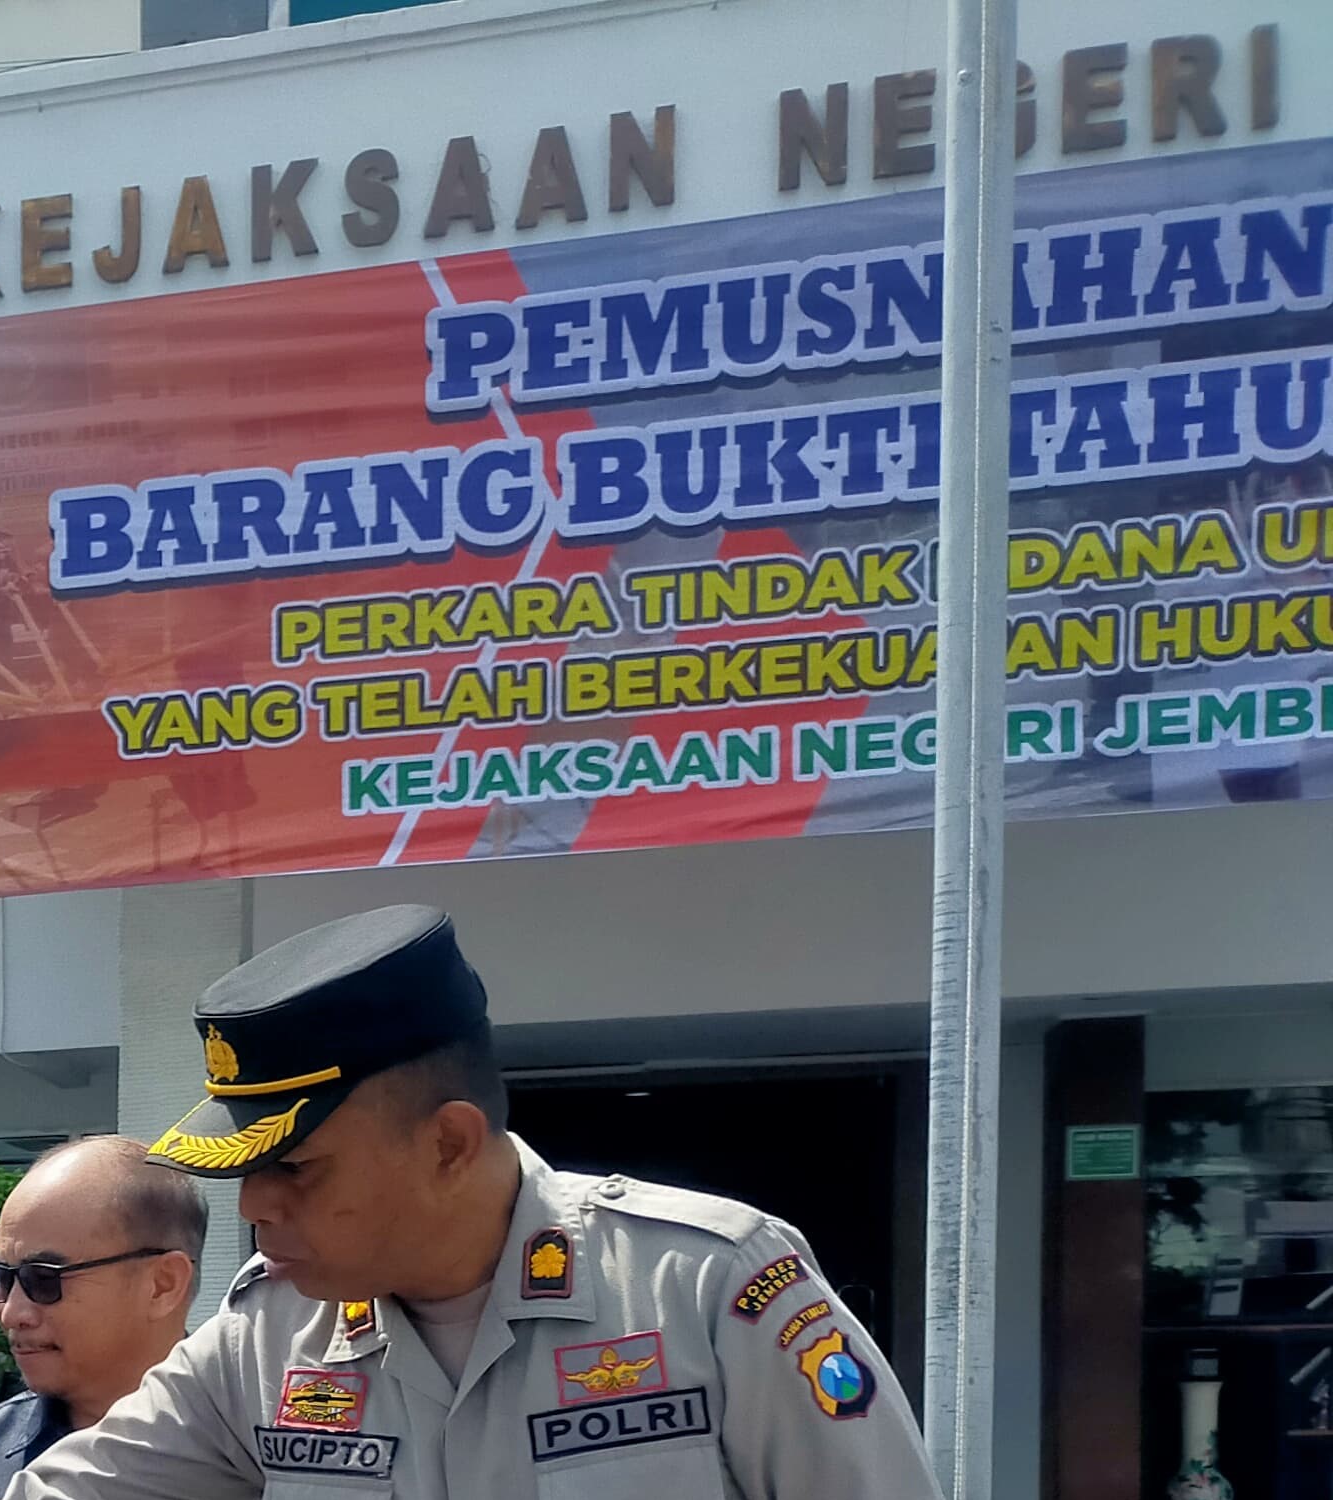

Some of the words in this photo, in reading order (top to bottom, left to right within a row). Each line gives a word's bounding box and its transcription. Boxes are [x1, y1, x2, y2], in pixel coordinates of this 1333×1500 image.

[59, 449, 536, 578] BARANG
[567, 402, 942, 526] BUKTI
[1008, 356, 1333, 478] TAHU
[280, 583, 610, 660] PERKARA
[633, 550, 918, 625] TINDAK
[1008, 519, 1239, 590] DANA
[111, 690, 298, 753] YANG
[316, 666, 552, 734] TELAH
[566, 611, 1115, 713] BERKEKUAAN
[348, 733, 773, 809] KEJAKSAAN
[800, 706, 1076, 779] NEGRI
[1105, 684, 1333, 750] JEMB
[737, 1259, 797, 1310] POLRES
[752, 1271, 798, 1311] JEMBER
[263, 1436, 380, 1467] SUCIPTO
[546, 1399, 694, 1448] POLRI
